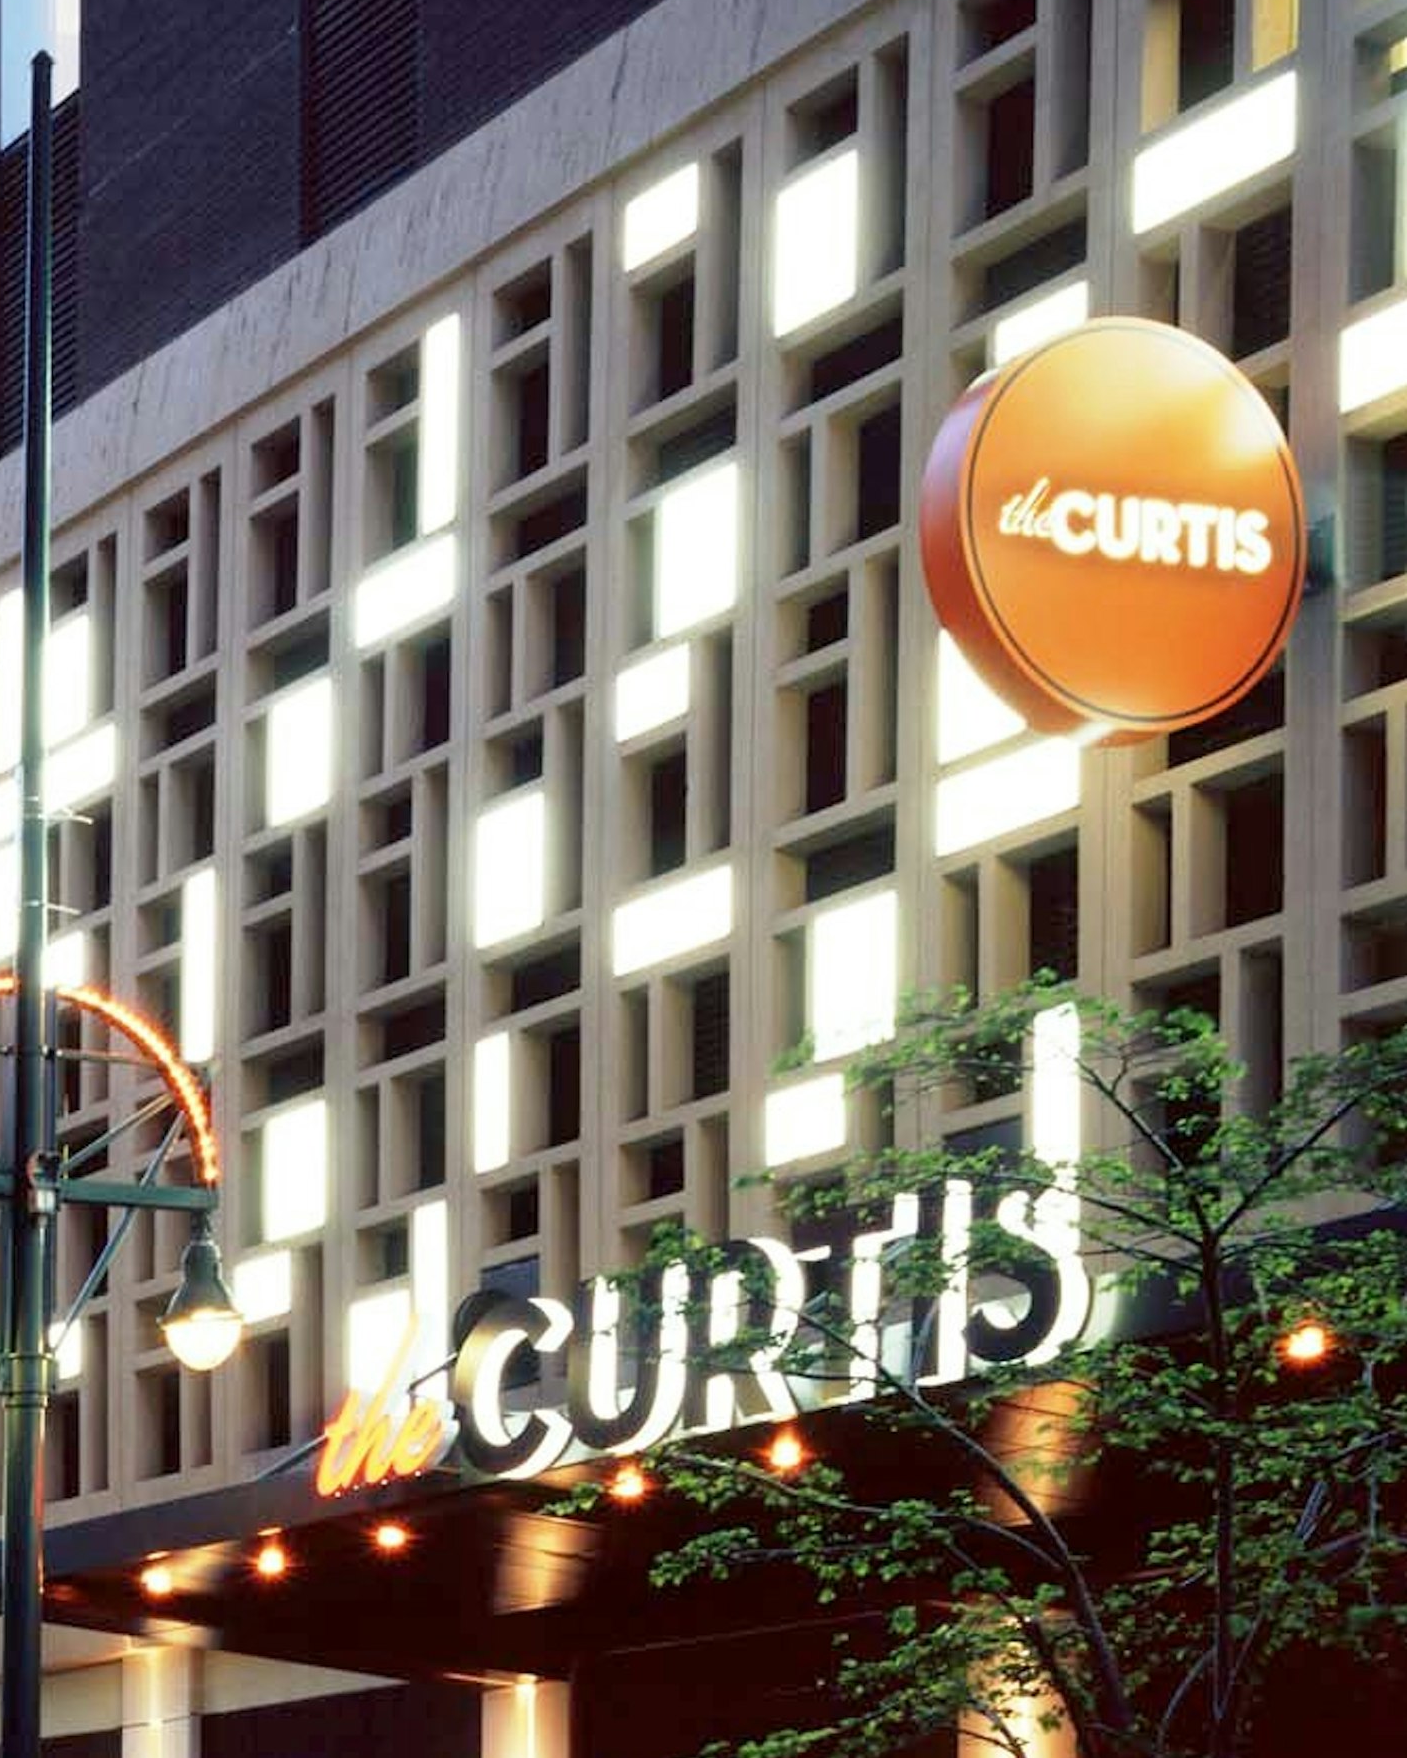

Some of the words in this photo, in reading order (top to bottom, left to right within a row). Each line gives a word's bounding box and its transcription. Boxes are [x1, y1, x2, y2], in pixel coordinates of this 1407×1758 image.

[999, 476, 1054, 538] the
[1051, 490, 1273, 575] CURTIS
[316, 1311, 445, 1497] the
[454, 1179, 1091, 1481] CURTIS
